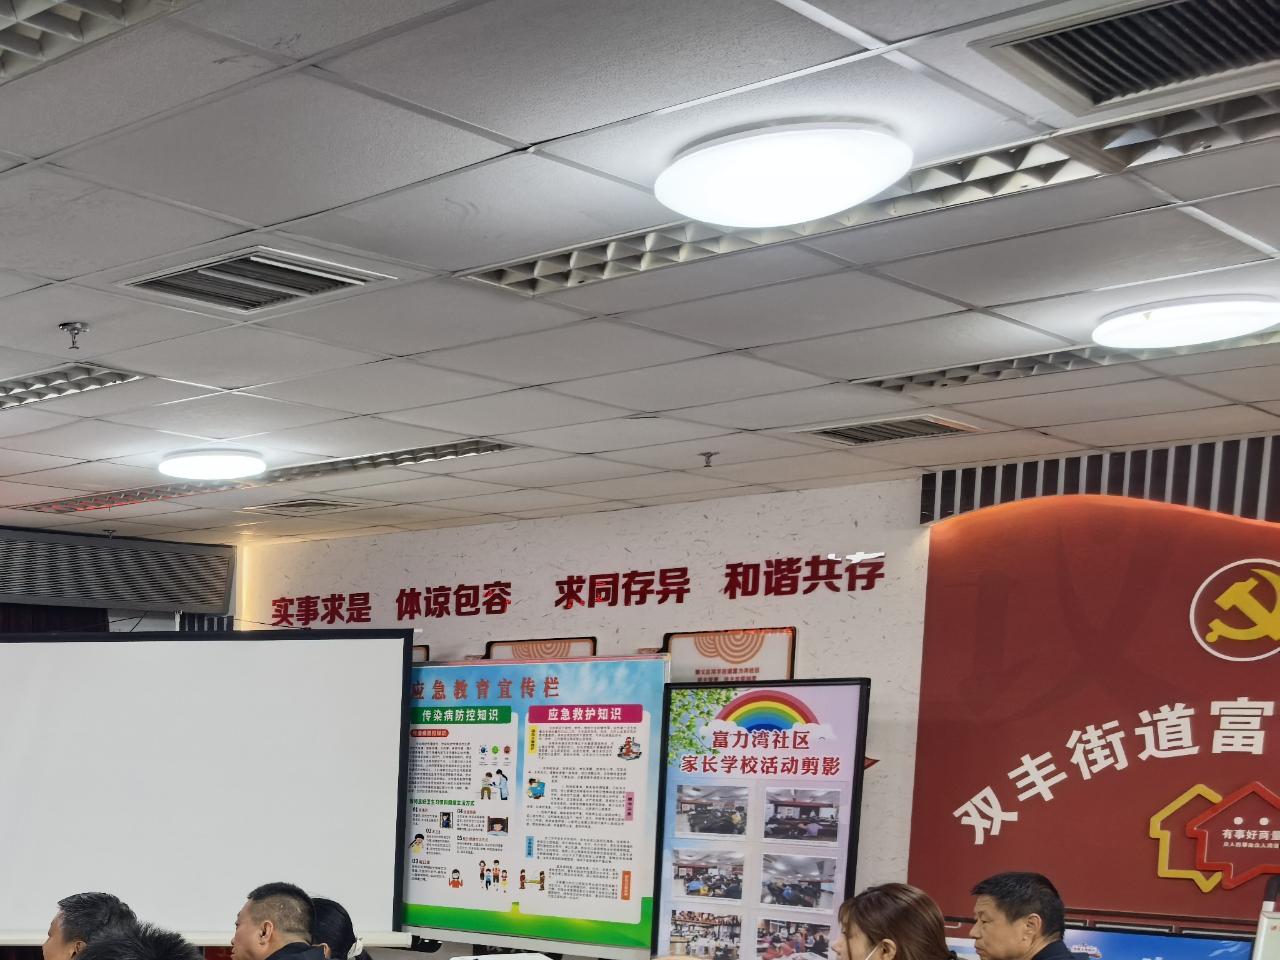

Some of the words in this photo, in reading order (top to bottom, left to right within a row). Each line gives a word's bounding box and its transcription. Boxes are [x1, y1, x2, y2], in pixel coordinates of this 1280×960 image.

[271, 592, 371, 626] 实事求是
[396, 581, 511, 621] 体谅包容
[555, 567, 690, 609] 求同存异
[724, 552, 885, 599] 和谐共存
[412, 676, 560, 700] 应急教育宣传栏
[422, 709, 499, 722] 传染病防控知识
[548, 707, 622, 720] 应急救护知识
[712, 729, 810, 751] 富力湾社区
[682, 755, 841, 776] 家长学校活动剪影
[953, 696, 1275, 845] 双丰街道富
